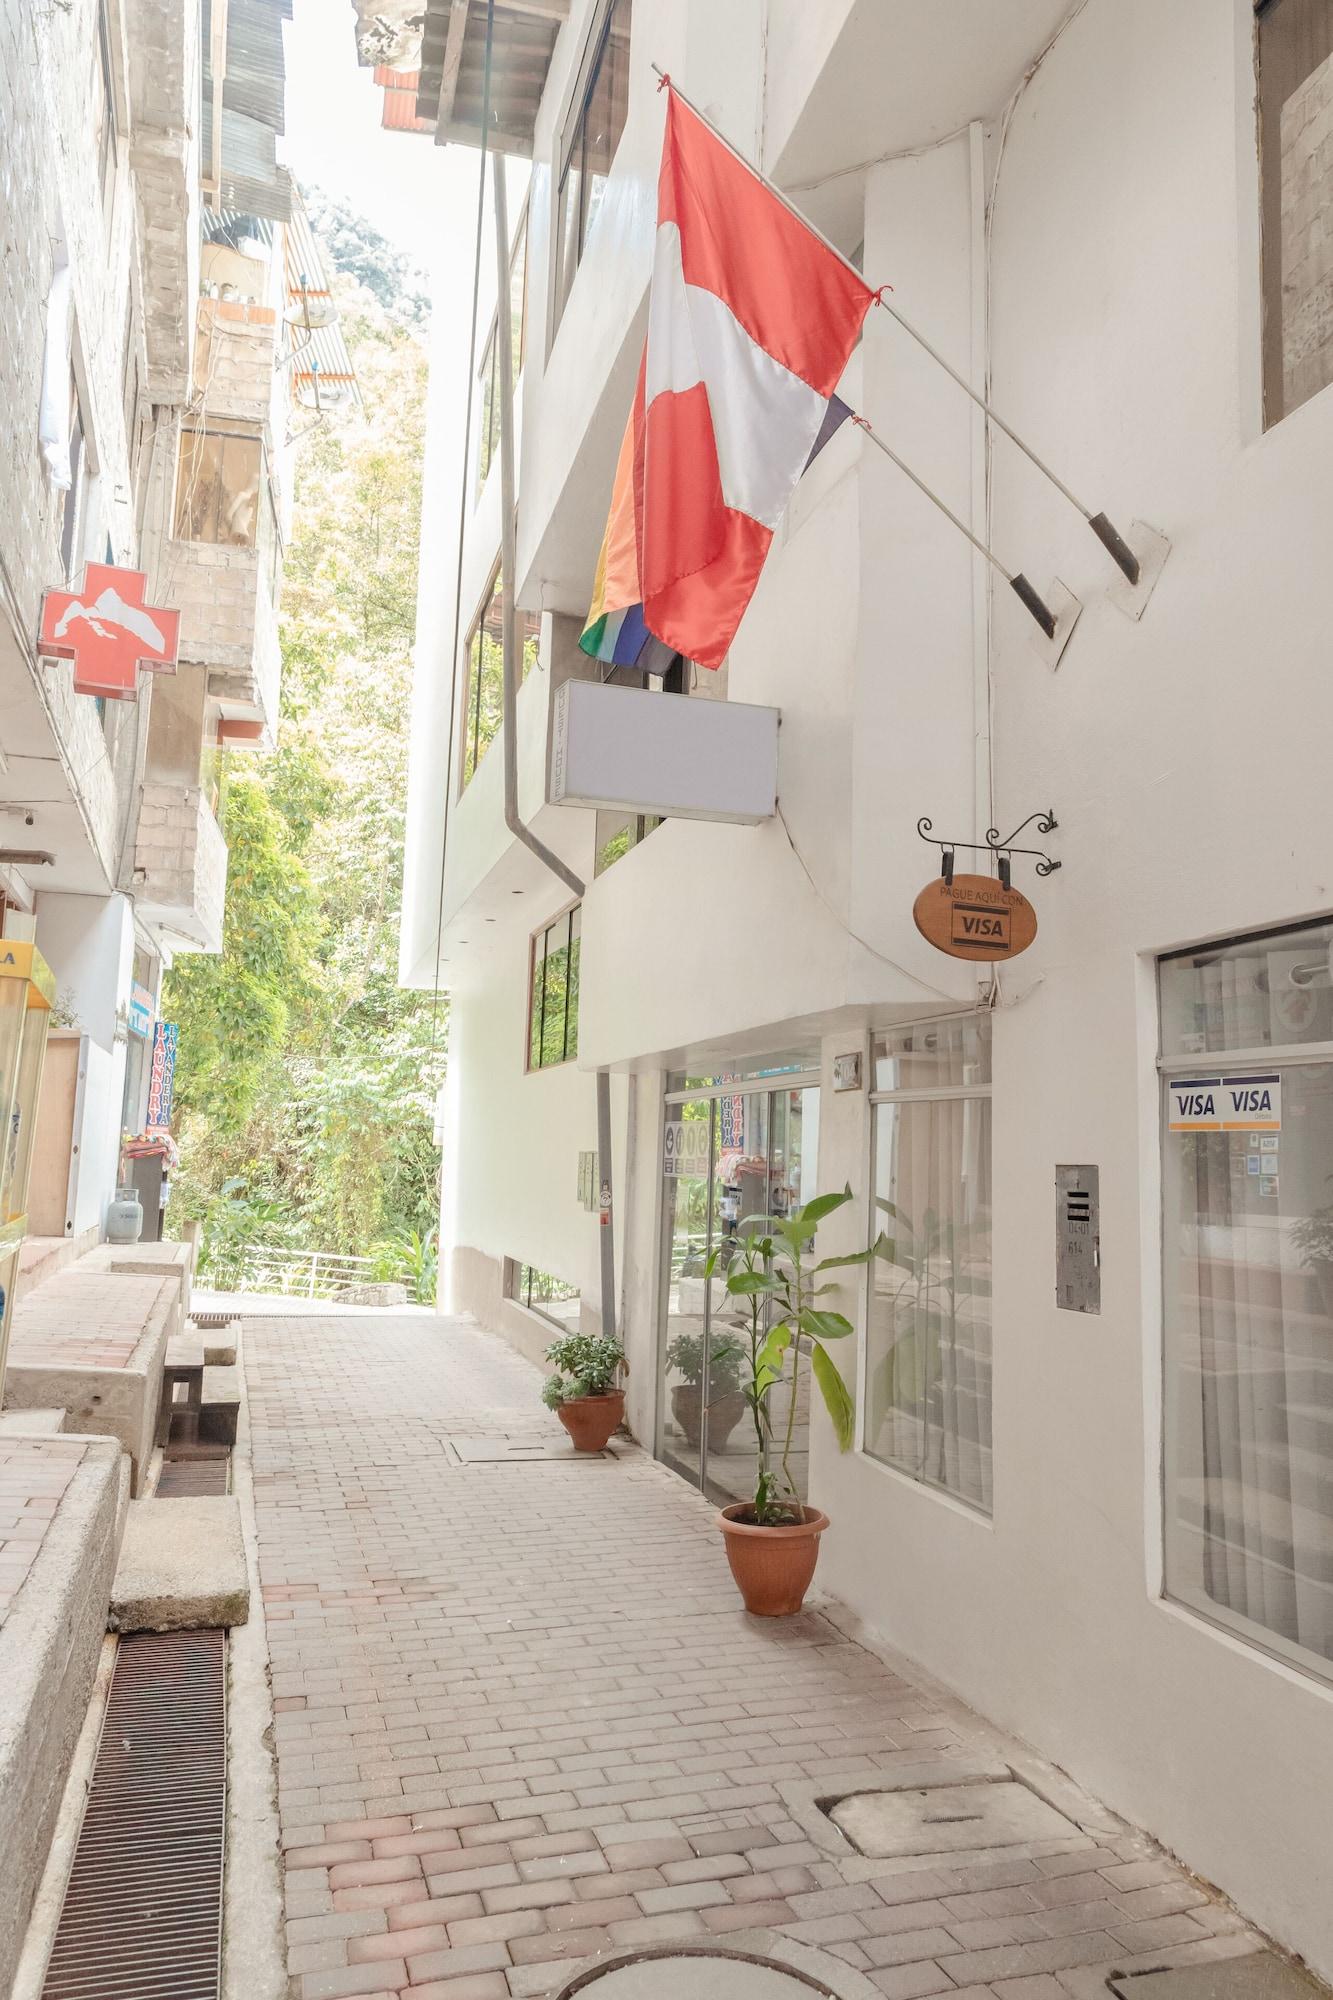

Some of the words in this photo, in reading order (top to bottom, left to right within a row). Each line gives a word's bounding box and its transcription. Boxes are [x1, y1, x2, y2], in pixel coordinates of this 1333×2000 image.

[940, 886, 973, 901] PAGUE
[976, 889, 1001, 903] AQUÍ
[961, 915, 1004, 937] VISA
[148, 1023, 167, 1125] LAUNDRY
[159, 1025, 177, 1126] LAVANDERIA
[1176, 1094, 1216, 1116] VISA
[1229, 1089, 1272, 1112] VISA
